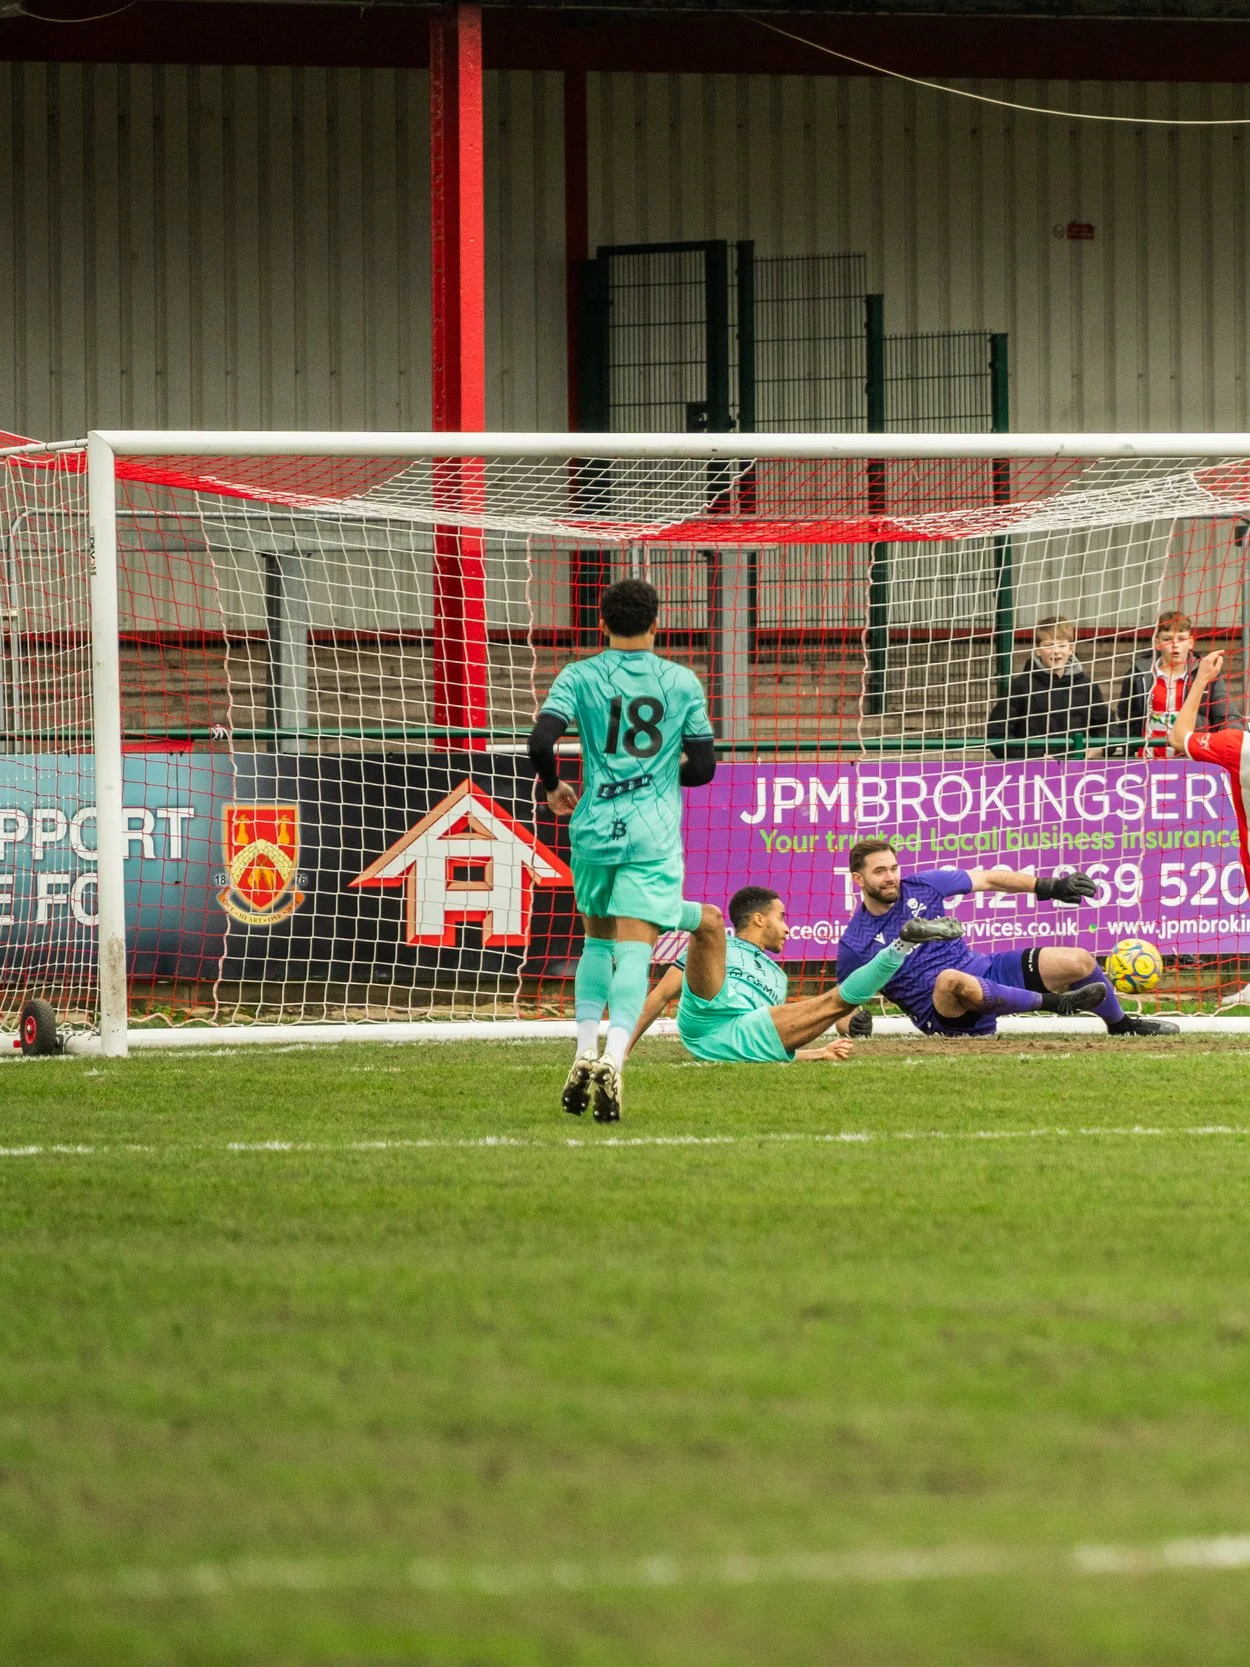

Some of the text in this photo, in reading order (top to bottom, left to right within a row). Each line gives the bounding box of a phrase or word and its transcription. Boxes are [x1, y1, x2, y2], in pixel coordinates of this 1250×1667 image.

[602, 694, 664, 758] 18
[759, 829, 819, 853] Your
[930, 826, 997, 851] Local
[1006, 825, 1115, 850] business
[1123, 826, 1240, 849] insurance
